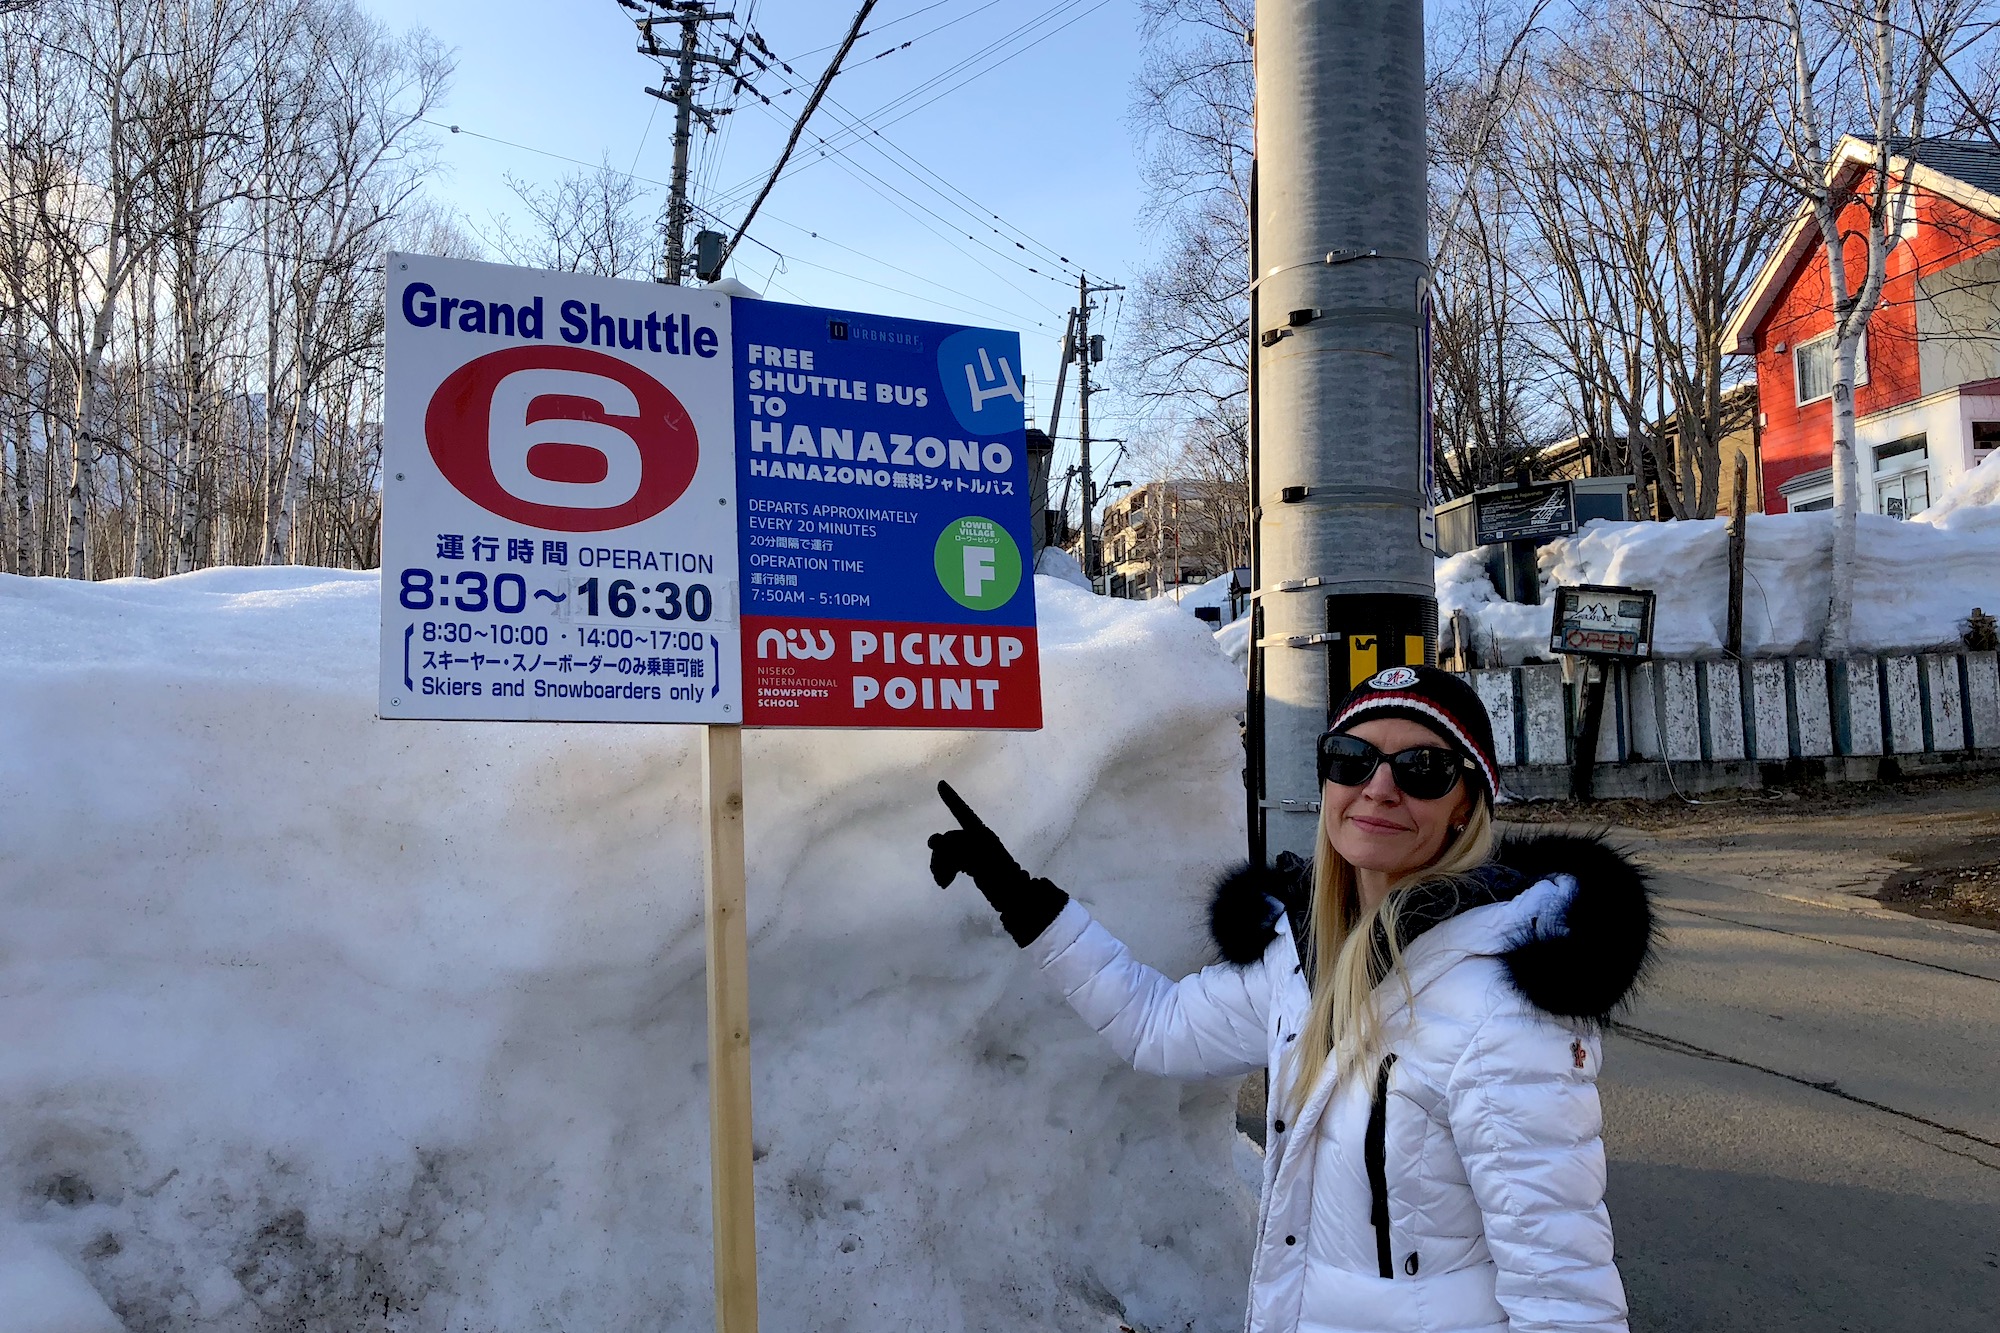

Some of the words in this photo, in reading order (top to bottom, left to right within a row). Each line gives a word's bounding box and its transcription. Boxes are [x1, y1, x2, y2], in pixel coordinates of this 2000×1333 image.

[402, 281, 543, 340] Grand
[559, 299, 719, 358] Shuttle
[748, 343, 814, 371] FREE
[748, 369, 868, 402] SHUTTLE
[875, 382, 928, 408] BUS
[749, 394, 787, 417] TO
[488, 368, 643, 510] 6
[750, 420, 1013, 474] HANAZONO
[750, 459, 1015, 496] HANAZONO無料シャトルバス
[749, 498, 809, 516] DEPARTS
[812, 504, 918, 524] APPROXIMATELY
[749, 516, 793, 531] EVERY
[797, 519, 815, 533] 20
[818, 521, 877, 538] MINUTES
[959, 528, 996, 538] VILLAGE
[961, 520, 993, 530] LOWER
[436, 533, 568, 566] 運行時間
[579, 547, 714, 574] OPERATION
[750, 553, 828, 571] OPERATION
[832, 559, 865, 573] TIME
[962, 545, 996, 597] F
[751, 572, 798, 587] 運行時間
[751, 588, 805, 603] 7:50AM
[819, 592, 870, 607] 5:10PM
[850, 630, 1024, 668] PICKUP
[1568, 630, 1634, 652] OPEN
[422, 650, 705, 678] スキーヤー・スノーボーダーのみ乗車可能
[757, 666, 796, 676] NISEKO
[422, 676, 482, 696] Skiers
[491, 678, 525, 697] and
[534, 678, 661, 700] Snowboarders
[669, 683, 705, 703] only
[757, 677, 838, 688] INTERNATIONAL
[757, 688, 829, 698] SNOWSPORTS
[852, 675, 1000, 711] POINT
[757, 698, 800, 708] SCHOOL
